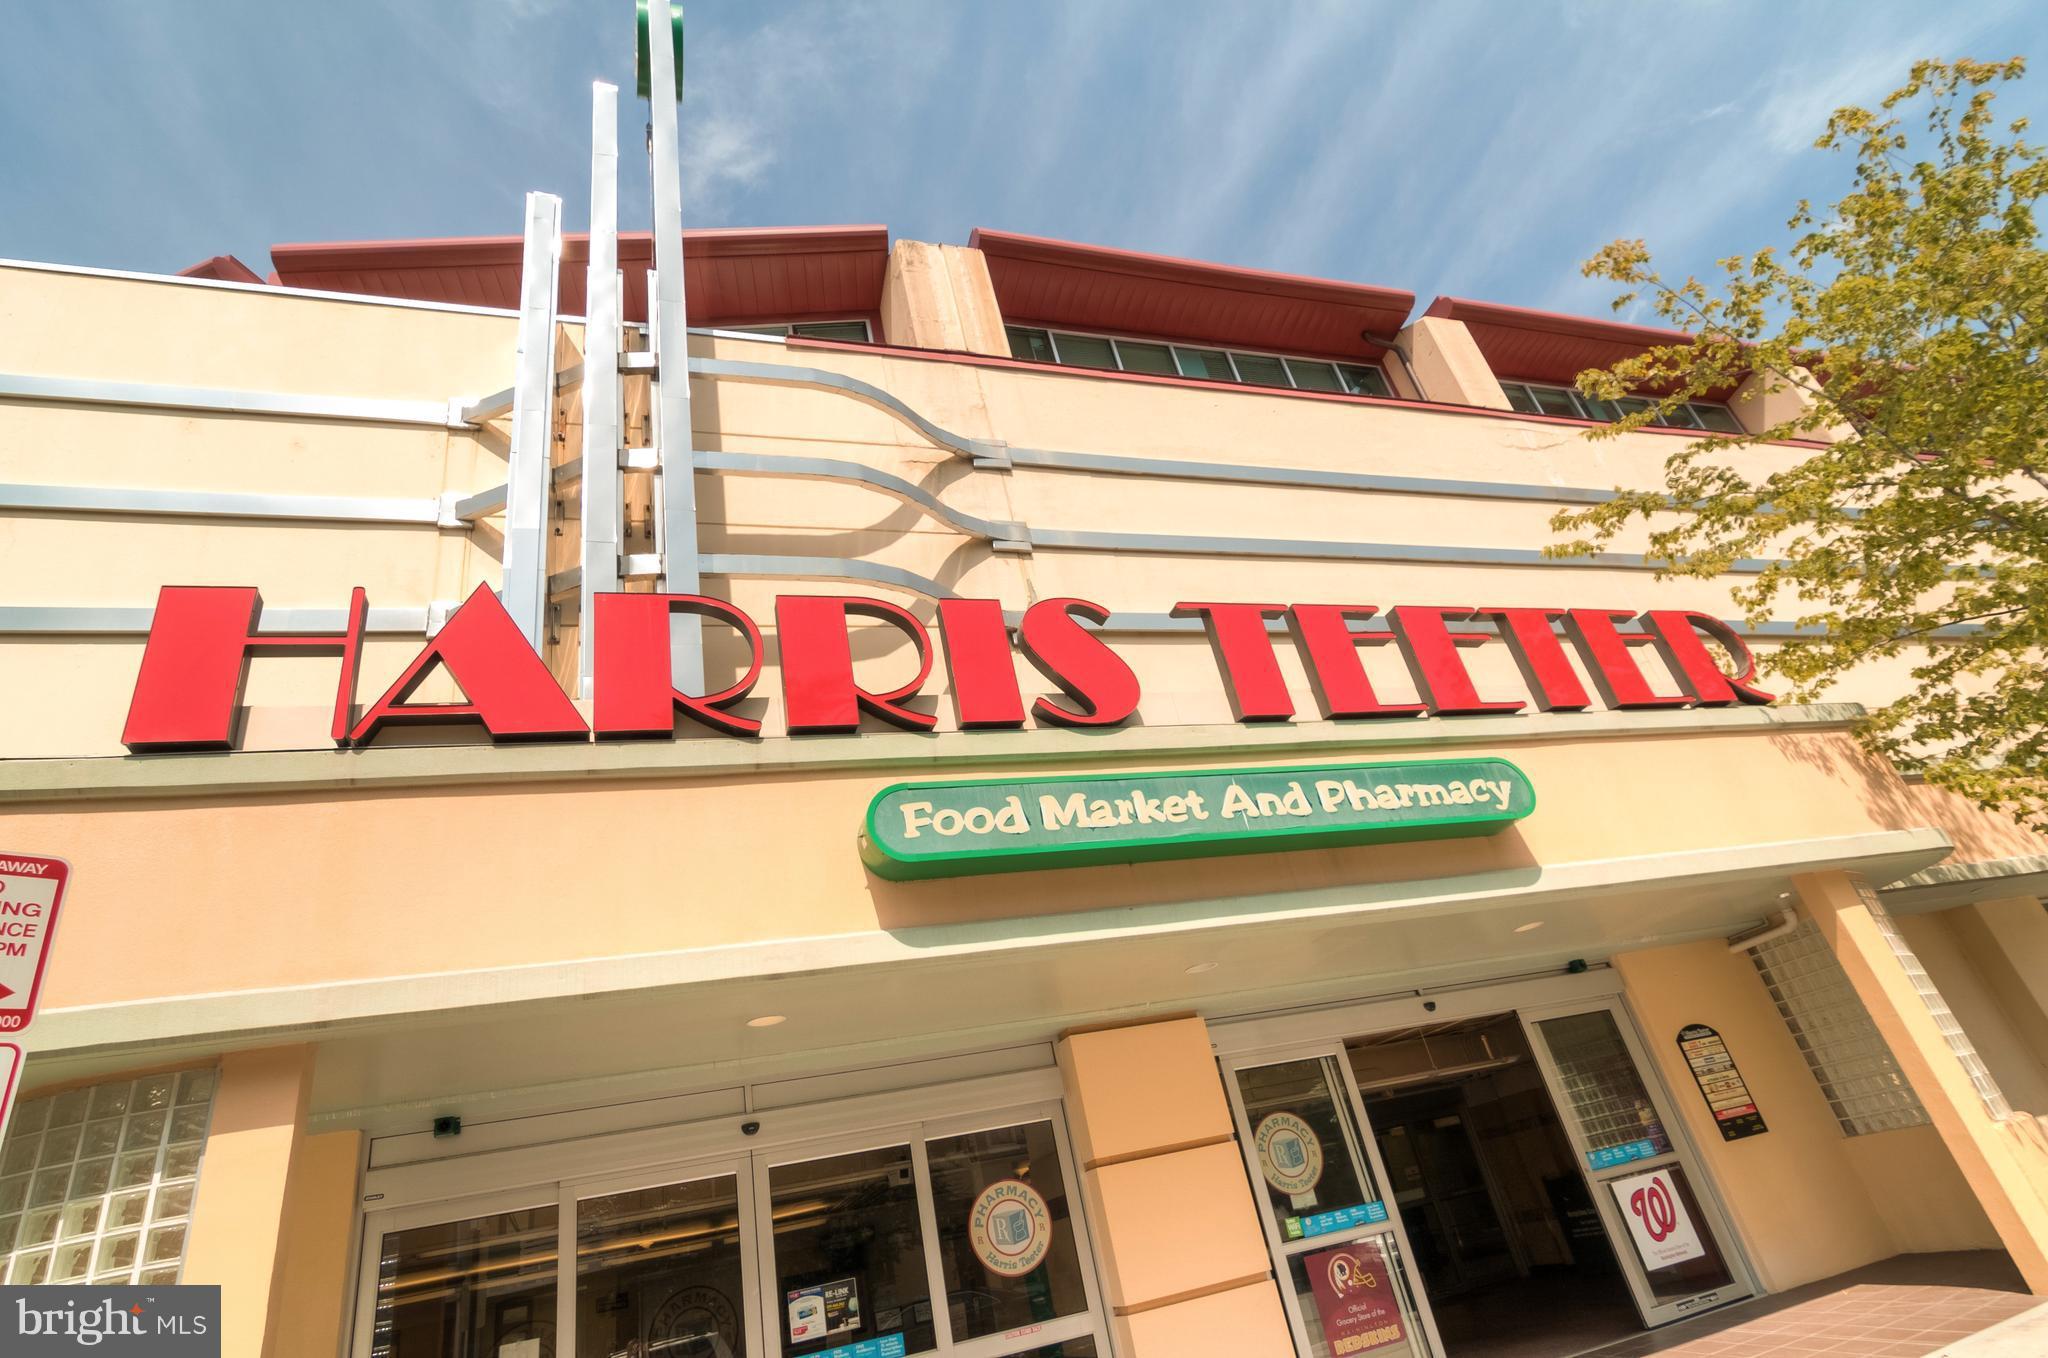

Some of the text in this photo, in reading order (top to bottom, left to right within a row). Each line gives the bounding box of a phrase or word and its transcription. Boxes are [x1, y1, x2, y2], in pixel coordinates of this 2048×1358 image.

[121, 581, 1777, 748] HARRIS TEETER
[899, 778, 1512, 839] Food Market And Pharmacy
[1258, 1116, 1315, 1153] PHARMACY
[974, 1183, 1045, 1229] PHARMACY
[985, 1240, 1045, 1270] Harris Teeter
